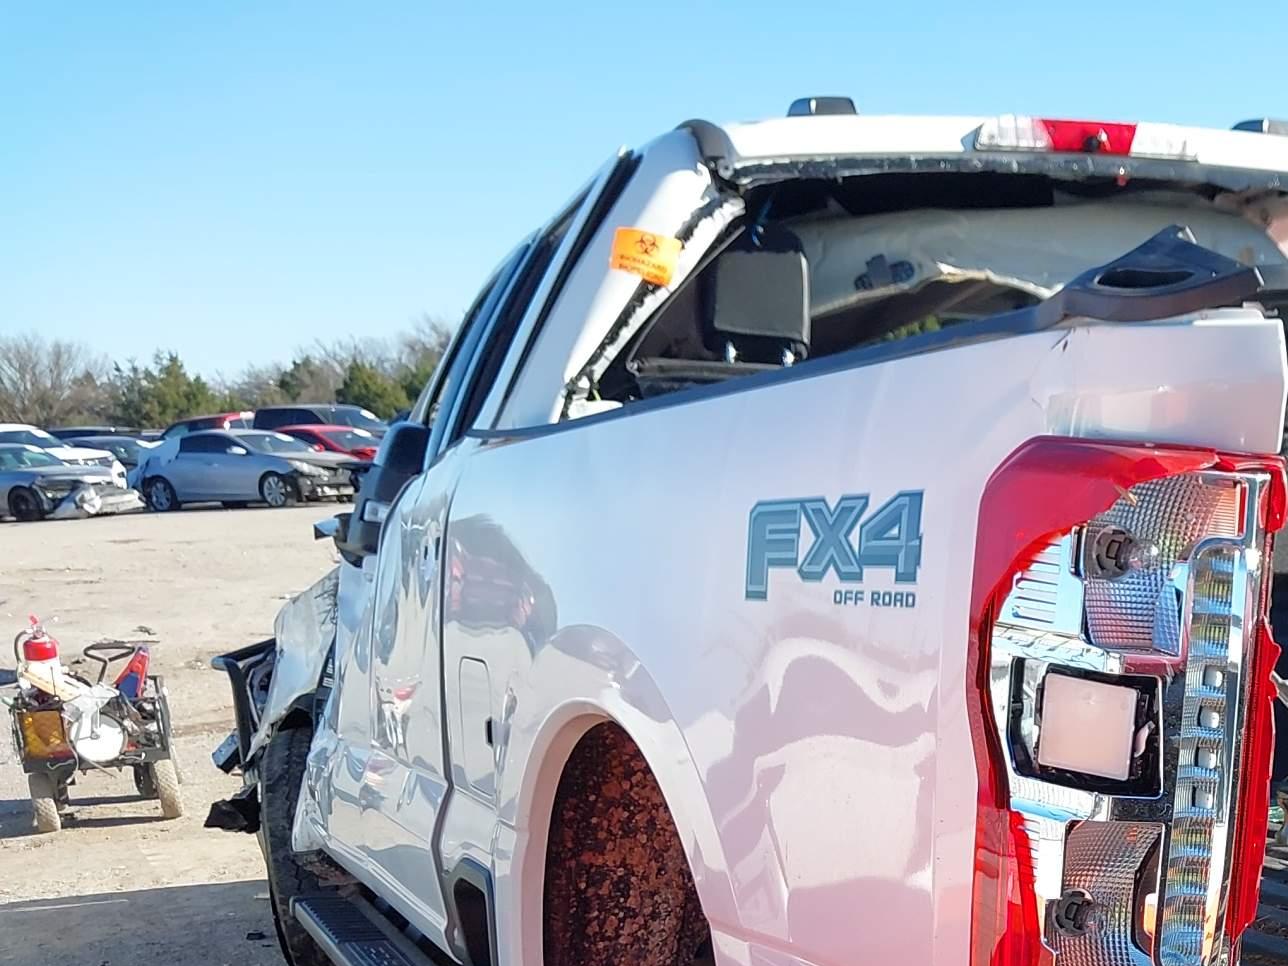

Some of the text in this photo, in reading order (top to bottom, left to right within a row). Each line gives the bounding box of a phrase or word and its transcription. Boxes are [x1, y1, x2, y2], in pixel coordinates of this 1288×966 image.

[745, 488, 924, 601] FX4
[833, 589, 917, 608] OFF ROAD
